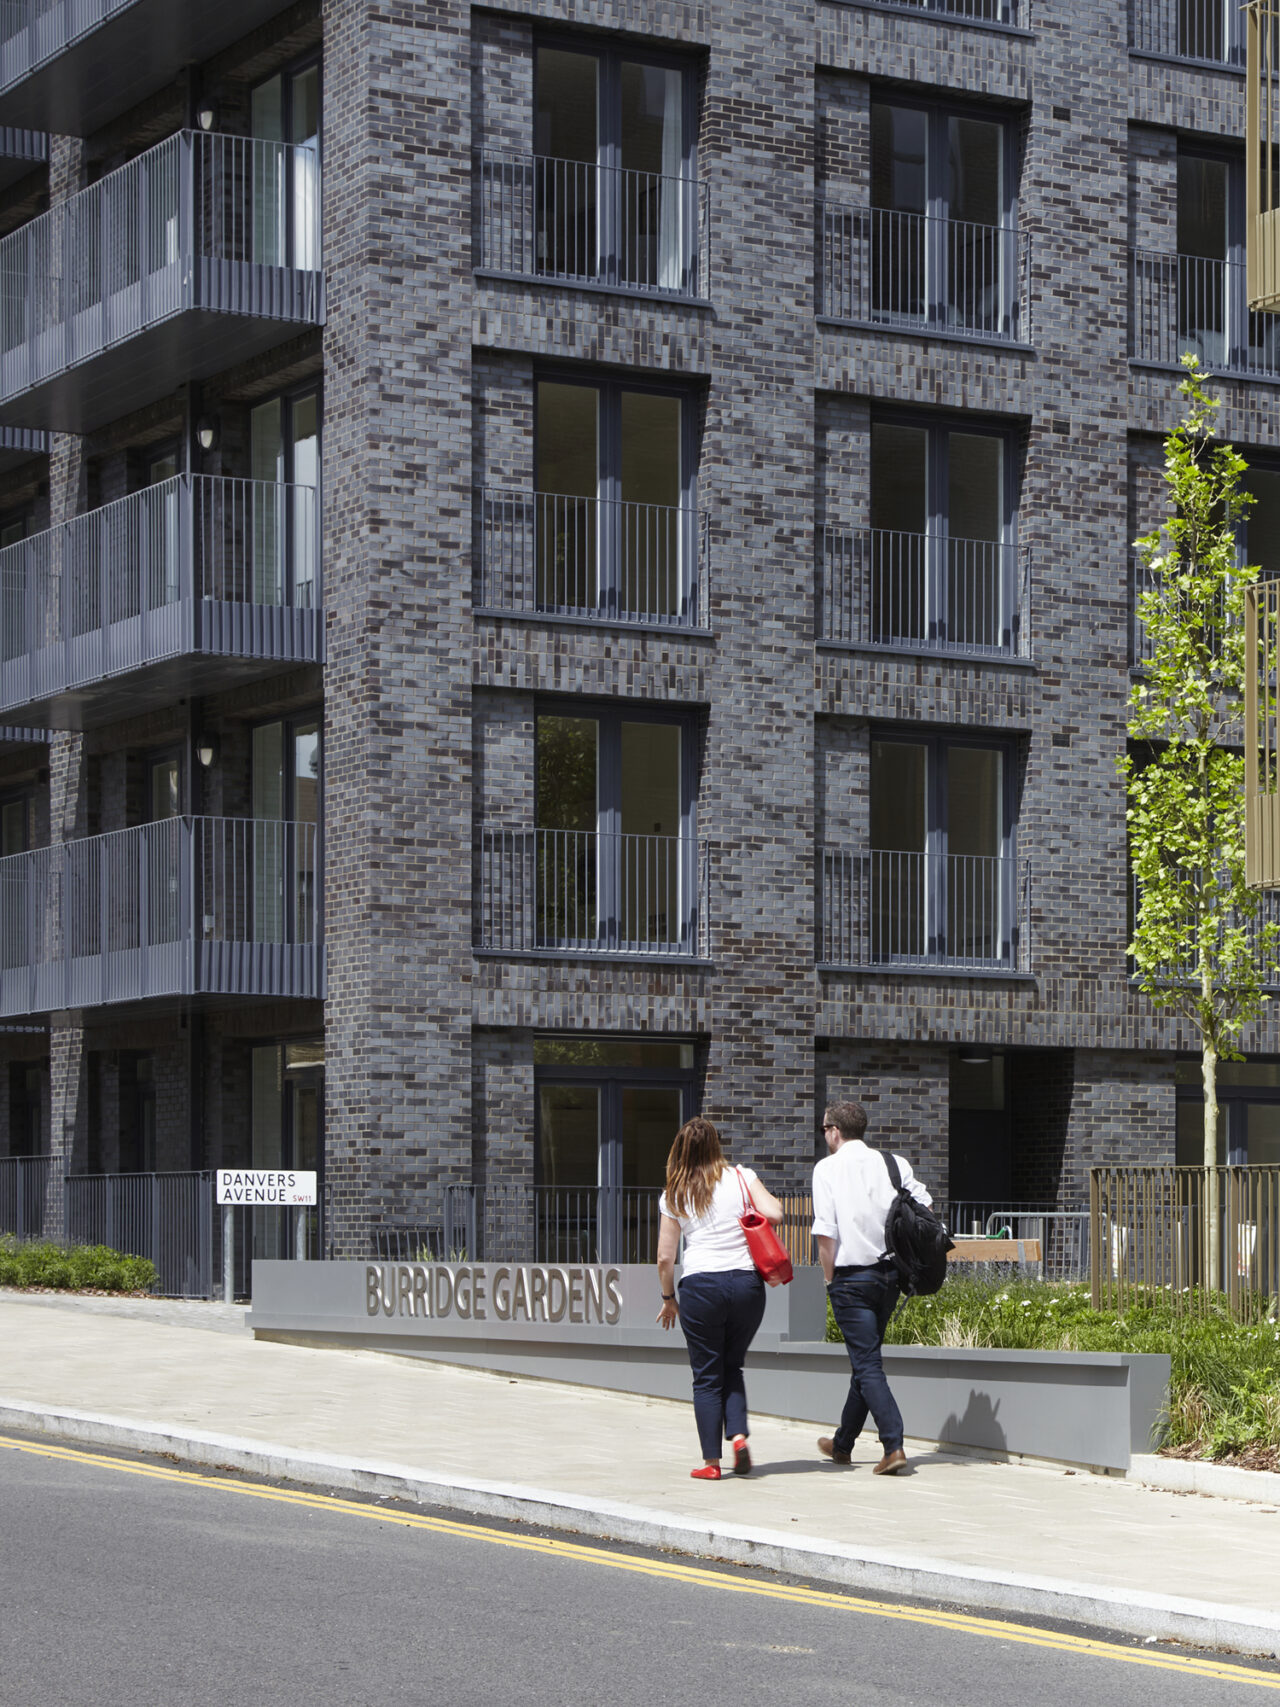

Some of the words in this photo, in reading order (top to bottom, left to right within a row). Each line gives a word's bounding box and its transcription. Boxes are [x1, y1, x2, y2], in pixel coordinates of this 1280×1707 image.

[223, 1173, 296, 1187] DANVERS
[223, 1188, 286, 1201] AVENUE
[292, 1194, 312, 1202] SW11
[365, 1265, 487, 1320] BURRIDGE
[492, 1267, 623, 1325] GARDENS
